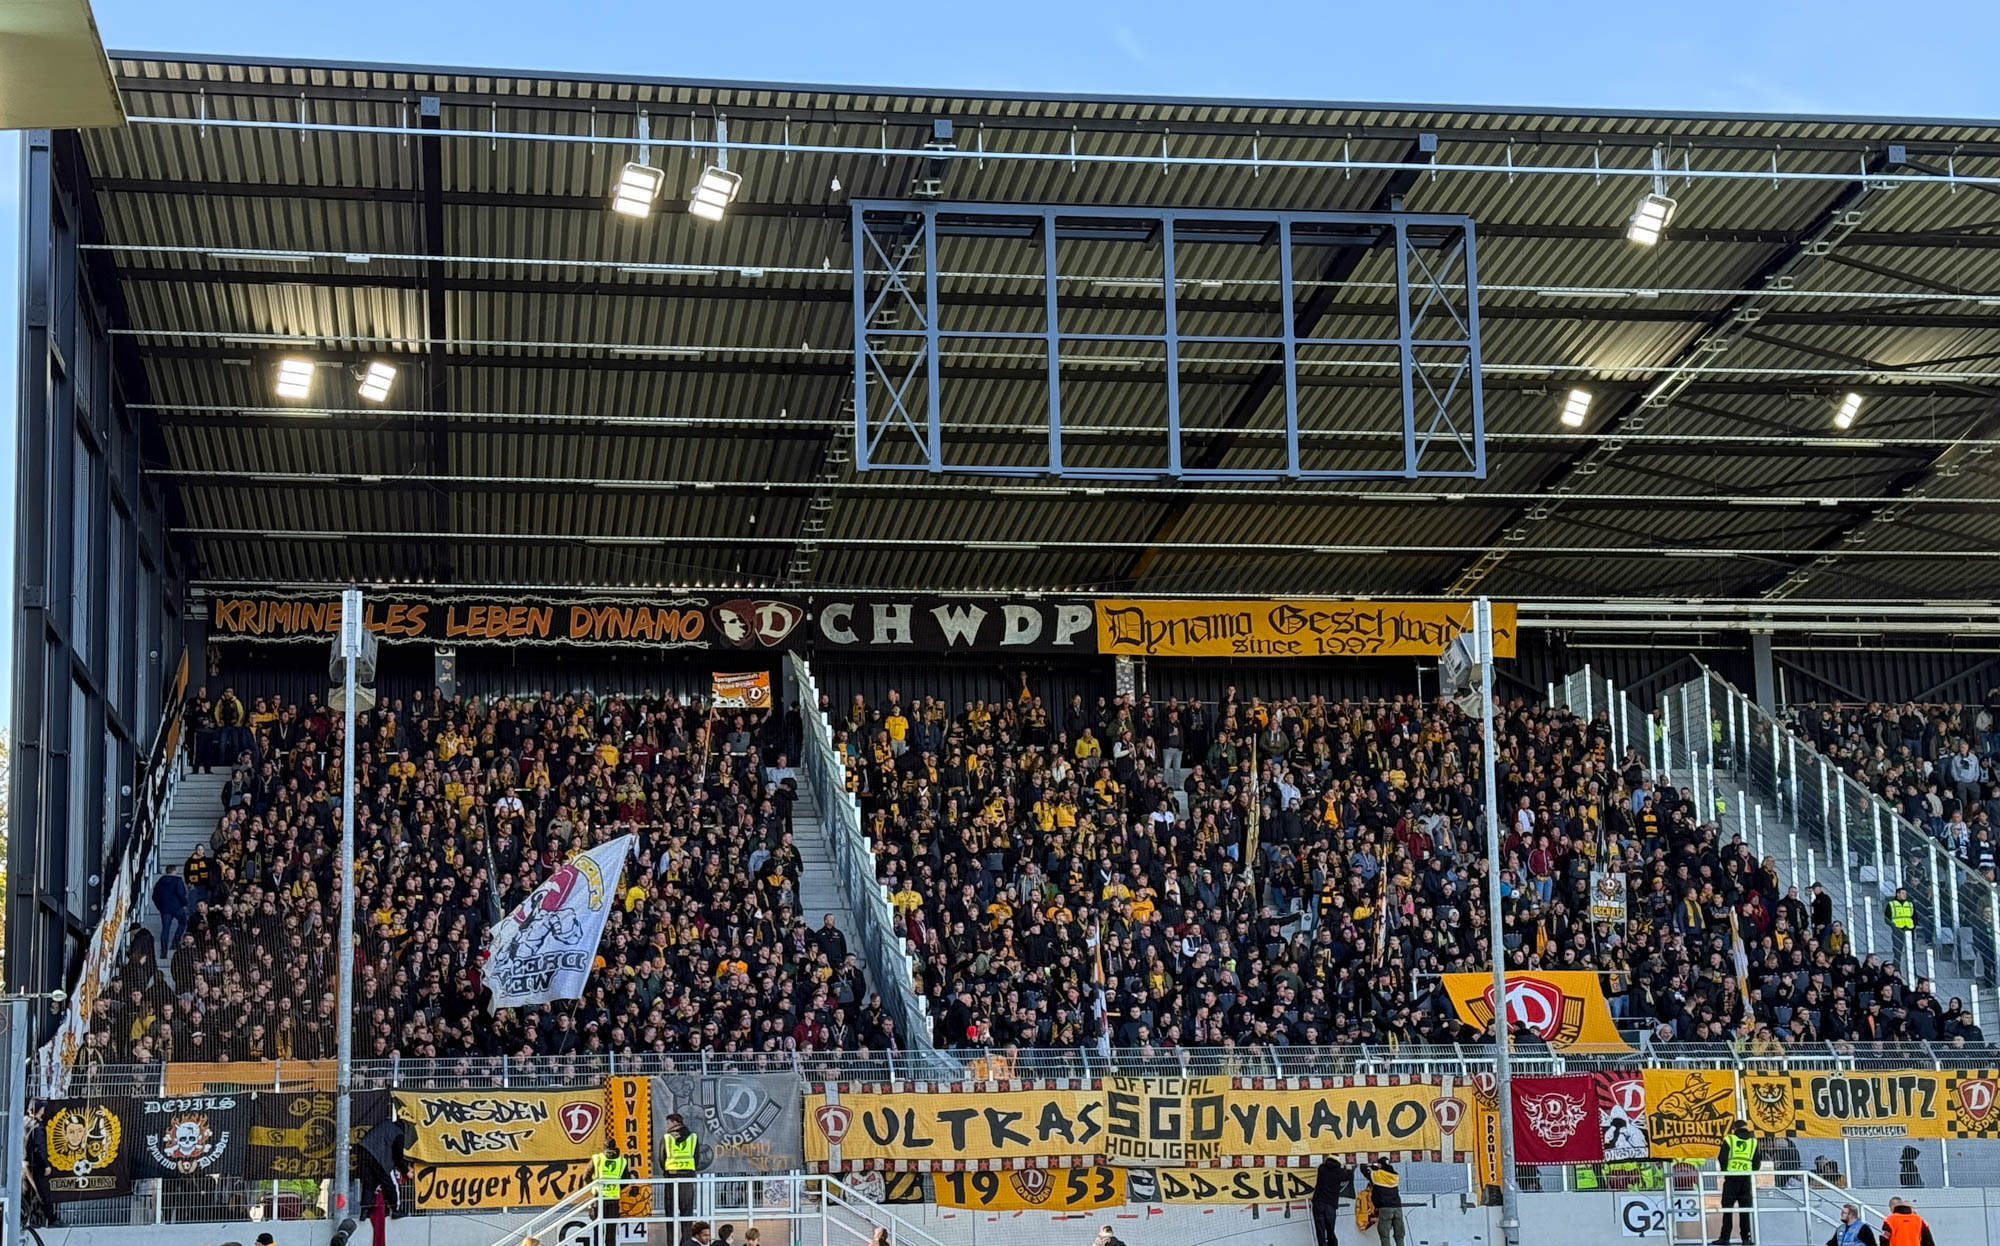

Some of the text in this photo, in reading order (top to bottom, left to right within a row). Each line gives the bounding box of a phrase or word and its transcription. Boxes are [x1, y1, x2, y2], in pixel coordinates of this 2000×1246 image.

[215, 599, 705, 641] KRIMINELES LEBEN DYNAMO
[1104, 604, 1510, 654] Dynamo Geschwadr
[1232, 637, 1385, 655] since 1997
[1112, 1077, 1214, 1096] OFFICIAL
[1811, 1073, 1937, 1119] GÖRLITZ
[421, 1098, 549, 1127] DRESDEN
[704, 1107, 763, 1147] DRESDEN
[1107, 1090, 1224, 1140] SGD
[1225, 1098, 1427, 1146] YNAMO
[1956, 1107, 2000, 1131] DRESDEN
[441, 1129, 535, 1155] WEST
[1651, 1115, 1734, 1140] LEUBNITZ
[1841, 1125, 1907, 1136] NIEDERSCHLESIEN
[417, 1163, 511, 1206] Jogger
[1017, 1186, 1051, 1203] DRESDEN
